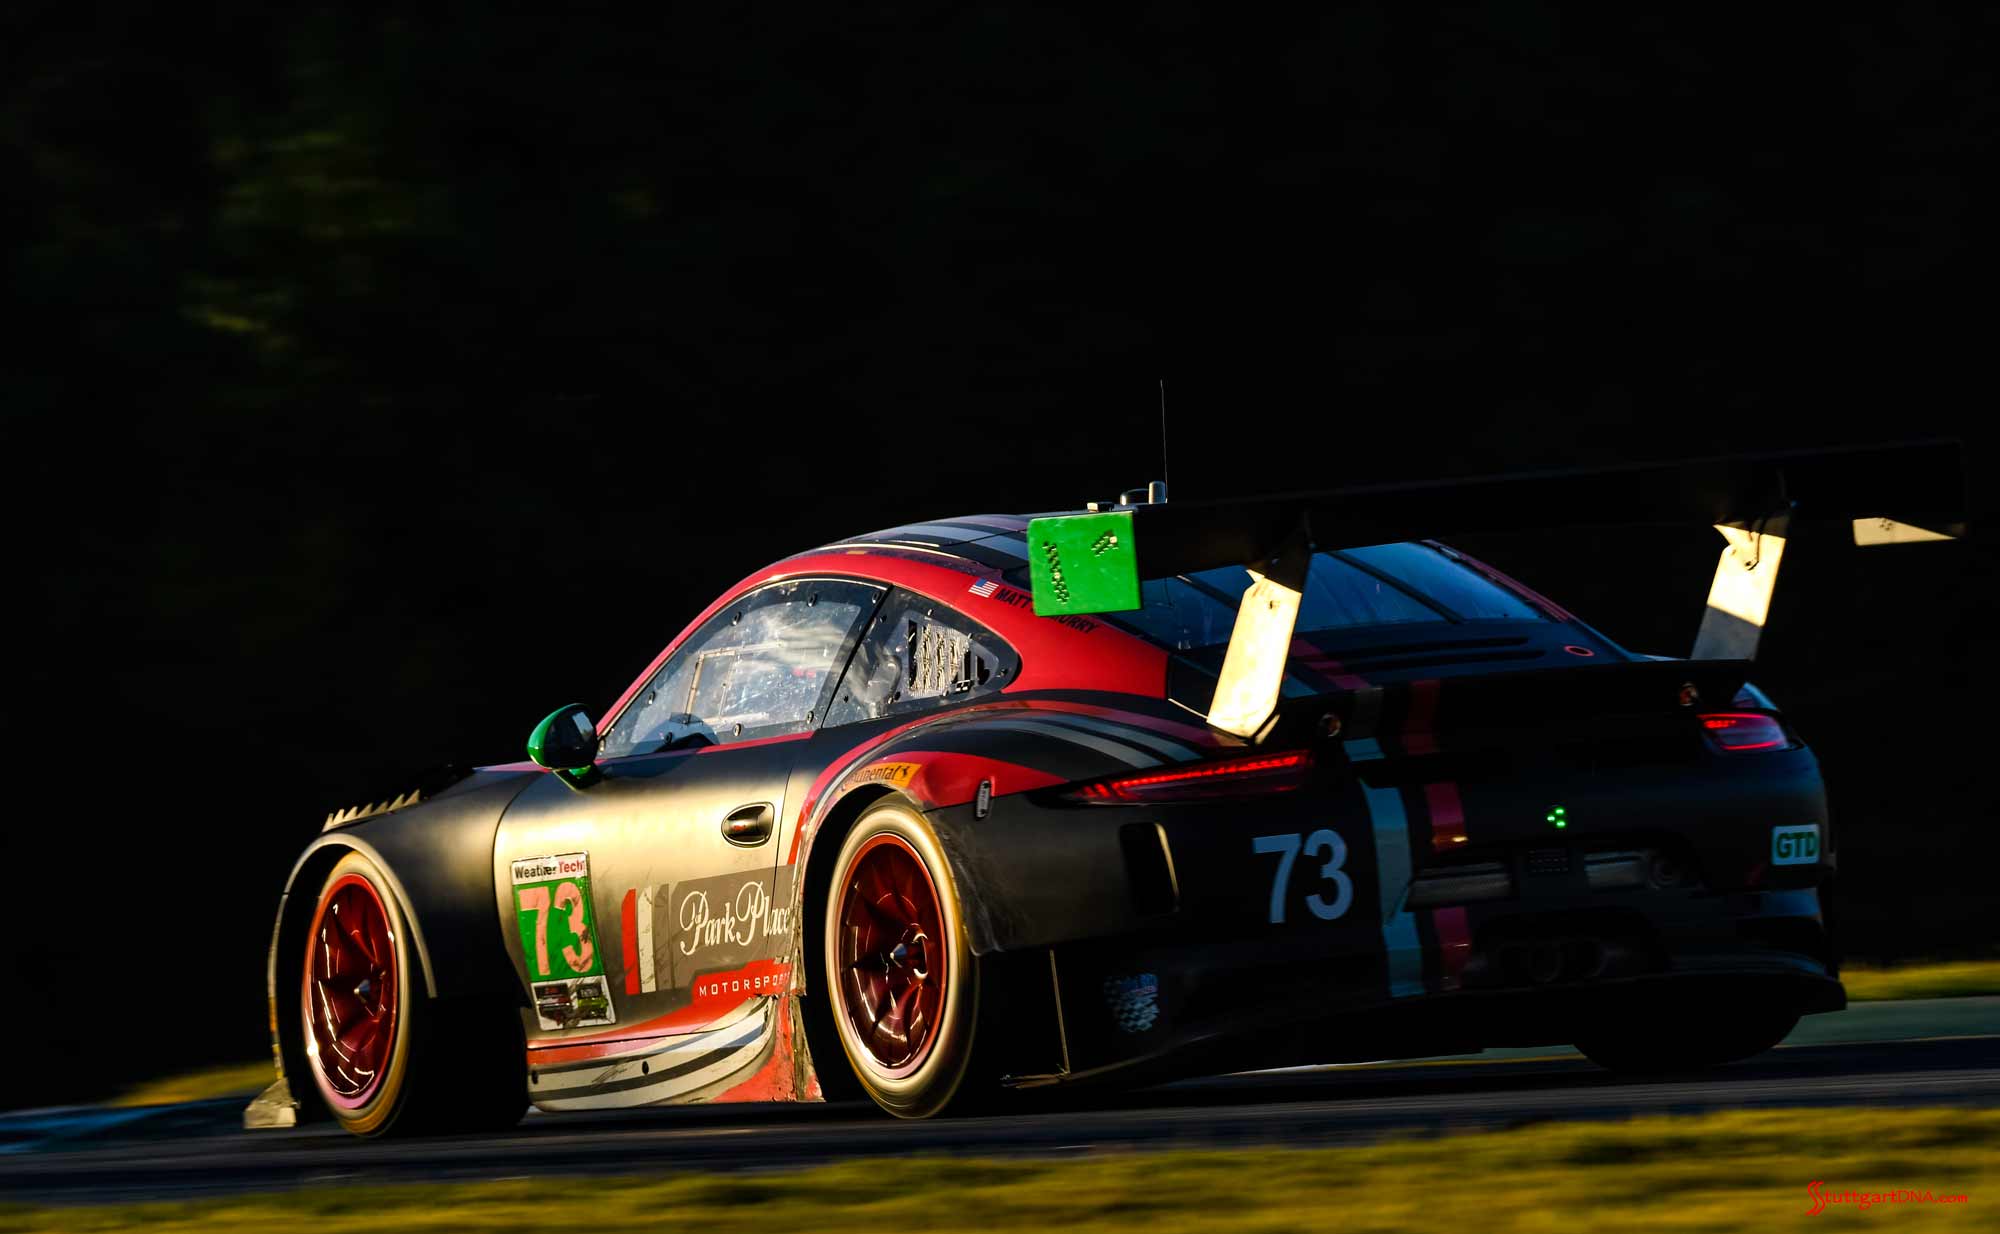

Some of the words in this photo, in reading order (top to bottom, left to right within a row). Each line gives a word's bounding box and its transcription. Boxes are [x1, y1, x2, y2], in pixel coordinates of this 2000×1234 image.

[1251, 829, 1354, 924] 73
[1776, 831, 1819, 858] GTD
[518, 881, 594, 977] 73
[680, 890, 735, 956] Park
